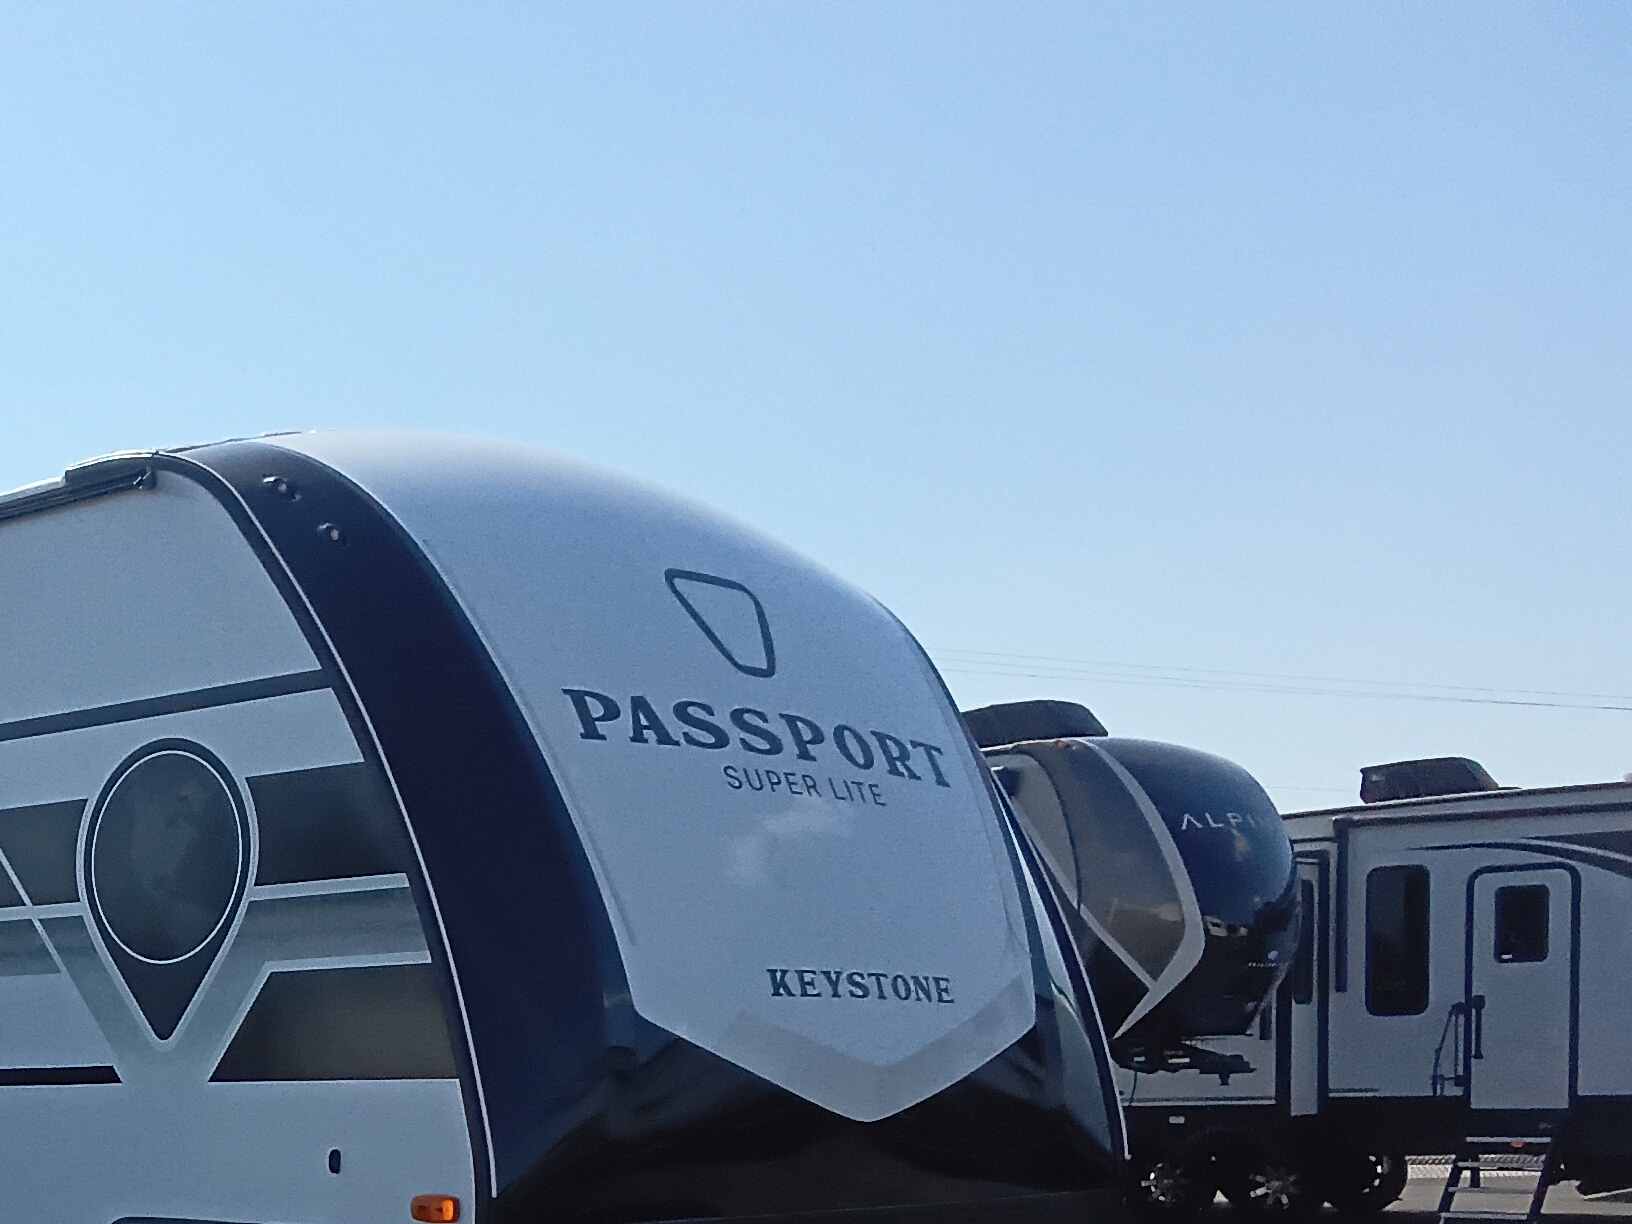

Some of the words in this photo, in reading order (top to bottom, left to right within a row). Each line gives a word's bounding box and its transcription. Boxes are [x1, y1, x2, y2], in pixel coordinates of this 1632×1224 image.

[561, 687, 951, 788] PASSPORT
[722, 765, 822, 799] SUPER
[829, 779, 887, 806] LITE
[766, 968, 955, 1004] KEYSTONE
